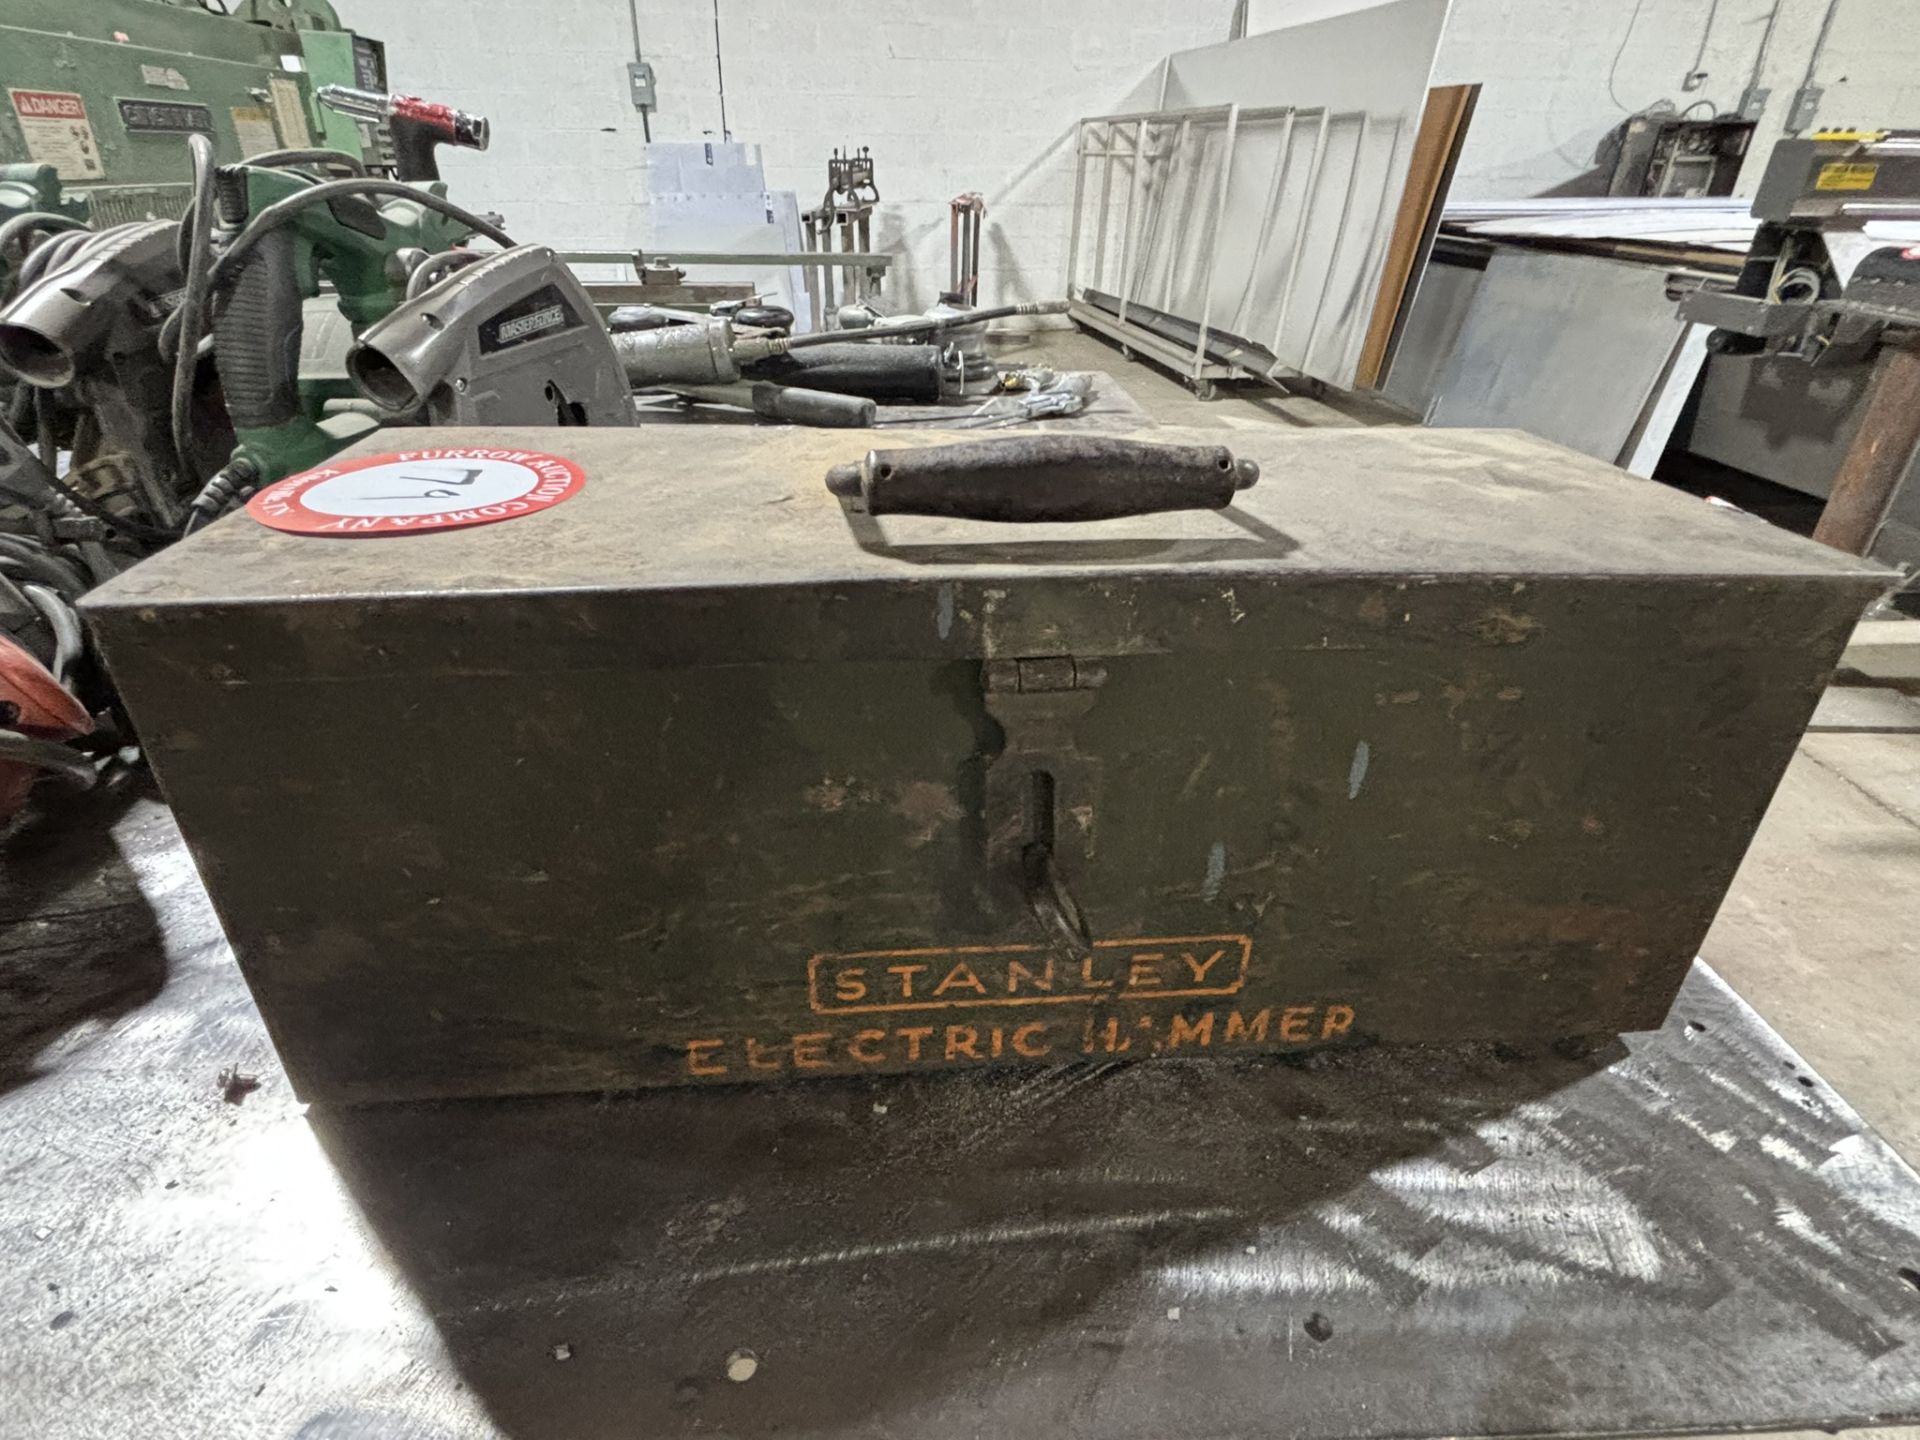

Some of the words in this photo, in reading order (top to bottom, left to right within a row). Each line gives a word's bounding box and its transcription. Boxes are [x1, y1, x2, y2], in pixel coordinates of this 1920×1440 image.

[30, 97, 82, 115] DANGER
[398, 448, 547, 462] FURROW
[526, 460, 573, 502] AUCTION
[318, 502, 530, 530] COMPANY
[834, 949, 1228, 1001] STANLEY
[686, 1021, 1053, 1076] ELECTRIC
